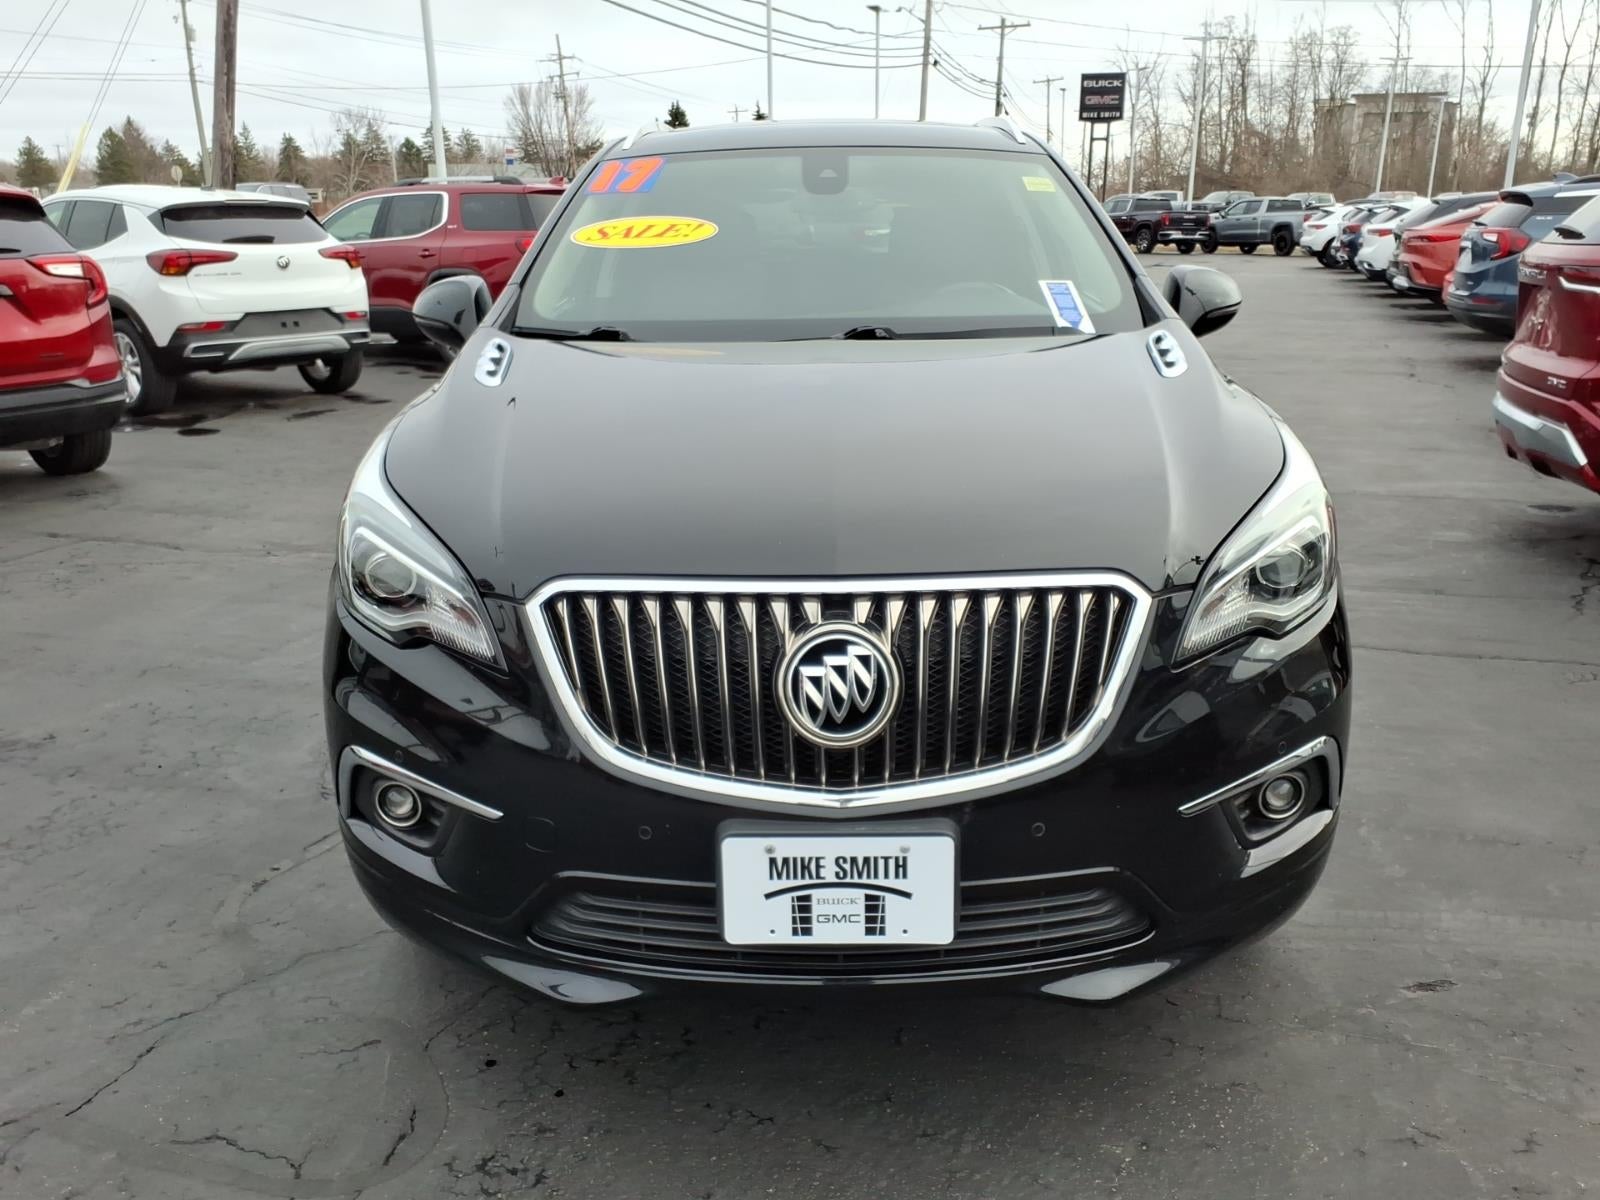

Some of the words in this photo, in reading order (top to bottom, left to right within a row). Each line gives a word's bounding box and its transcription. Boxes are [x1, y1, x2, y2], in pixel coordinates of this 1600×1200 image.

[1085, 95, 1120, 104] GMC
[585, 223, 705, 241] SALE!
[768, 856, 827, 881] MIKE
[834, 855, 908, 880] SMITH
[816, 897, 861, 905] BUICK
[816, 914, 861, 923] GMC
